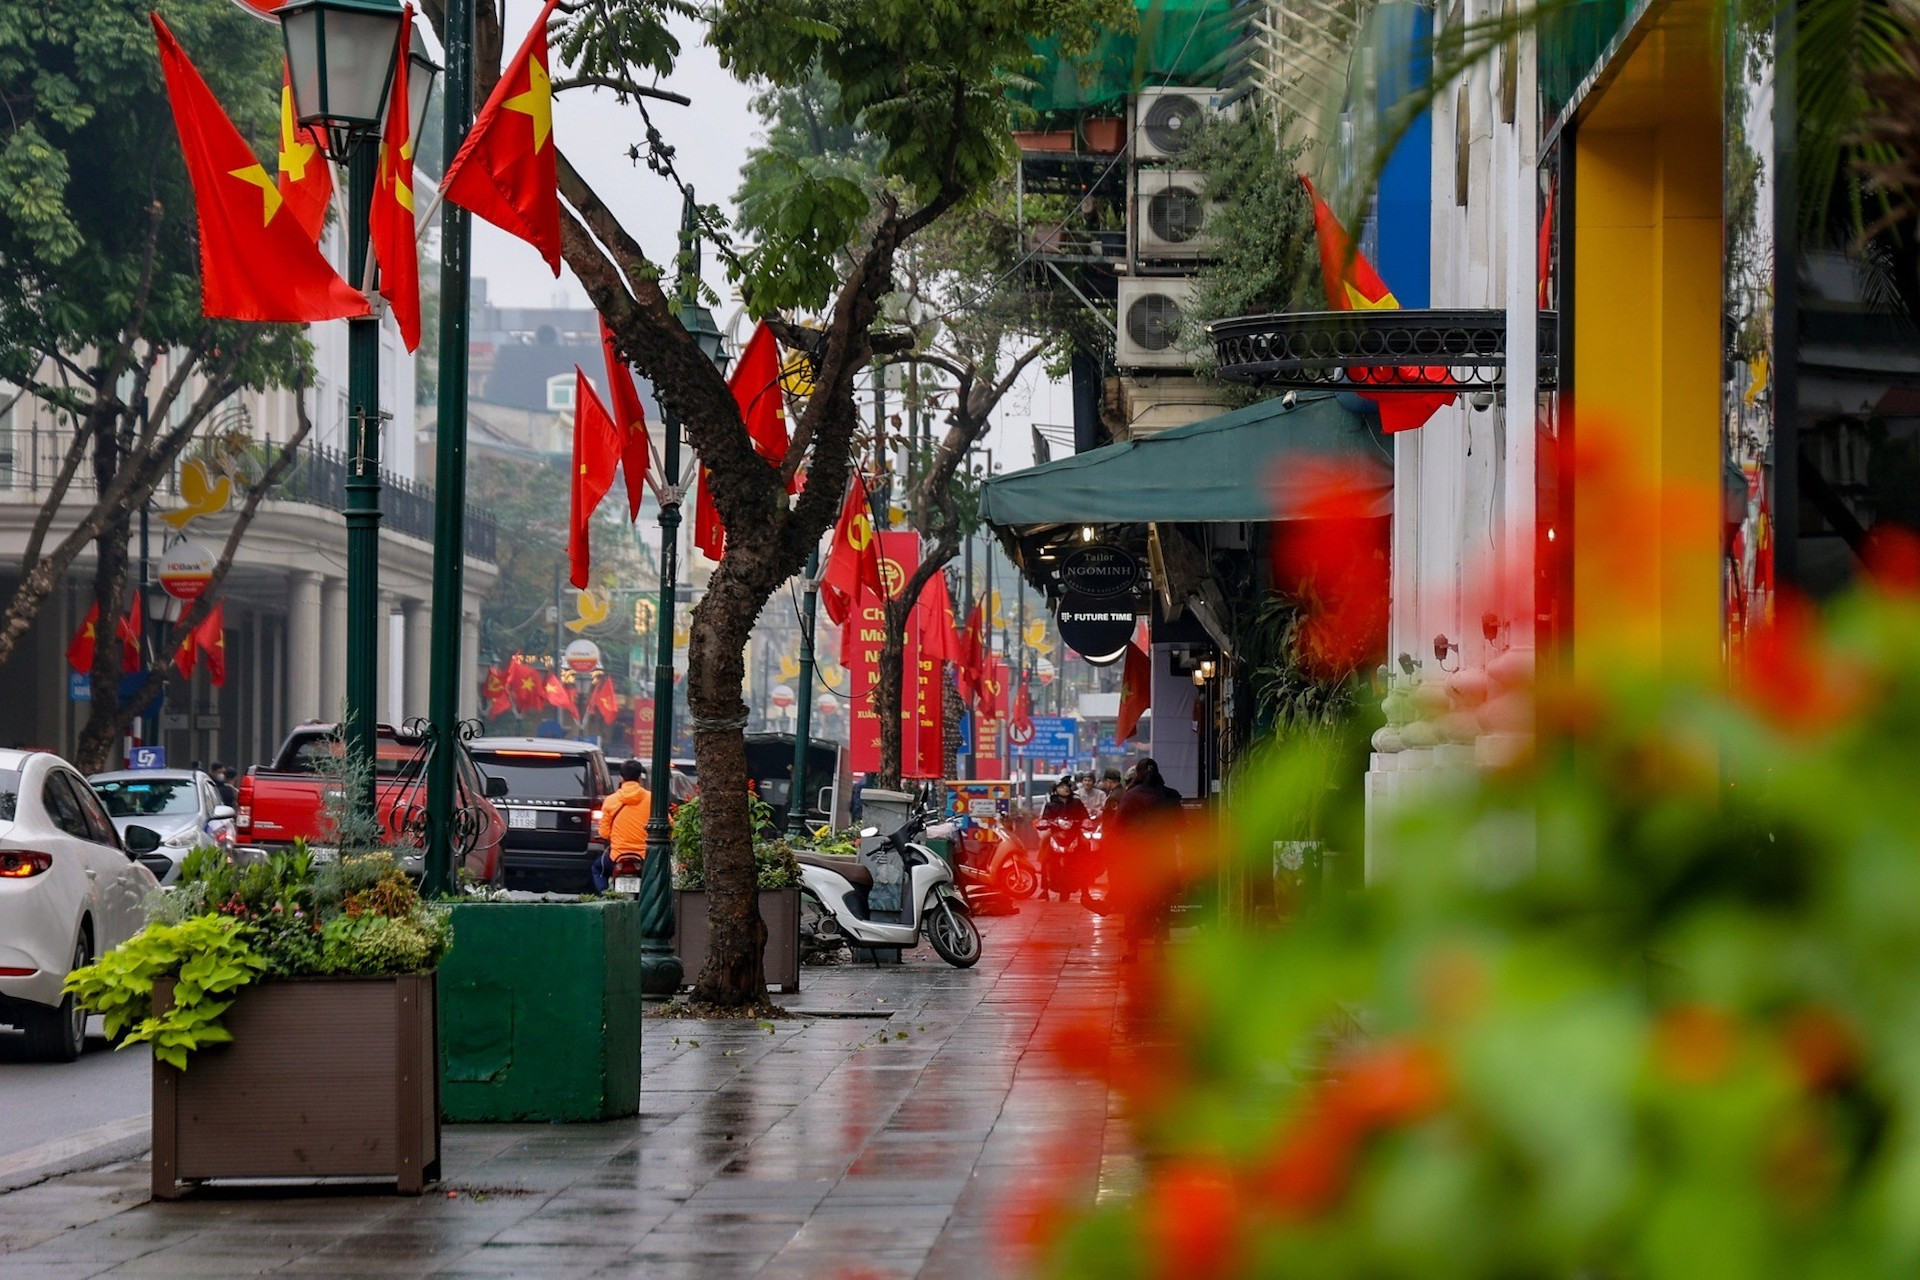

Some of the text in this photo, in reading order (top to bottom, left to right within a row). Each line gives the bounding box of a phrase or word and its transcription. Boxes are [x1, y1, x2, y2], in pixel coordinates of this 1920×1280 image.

[1084, 553, 1114, 561] Tailor
[1067, 566, 1131, 576] NGOMINH
[1074, 612, 1132, 621] FUTURE TIME
[137, 749, 156, 767] G7
